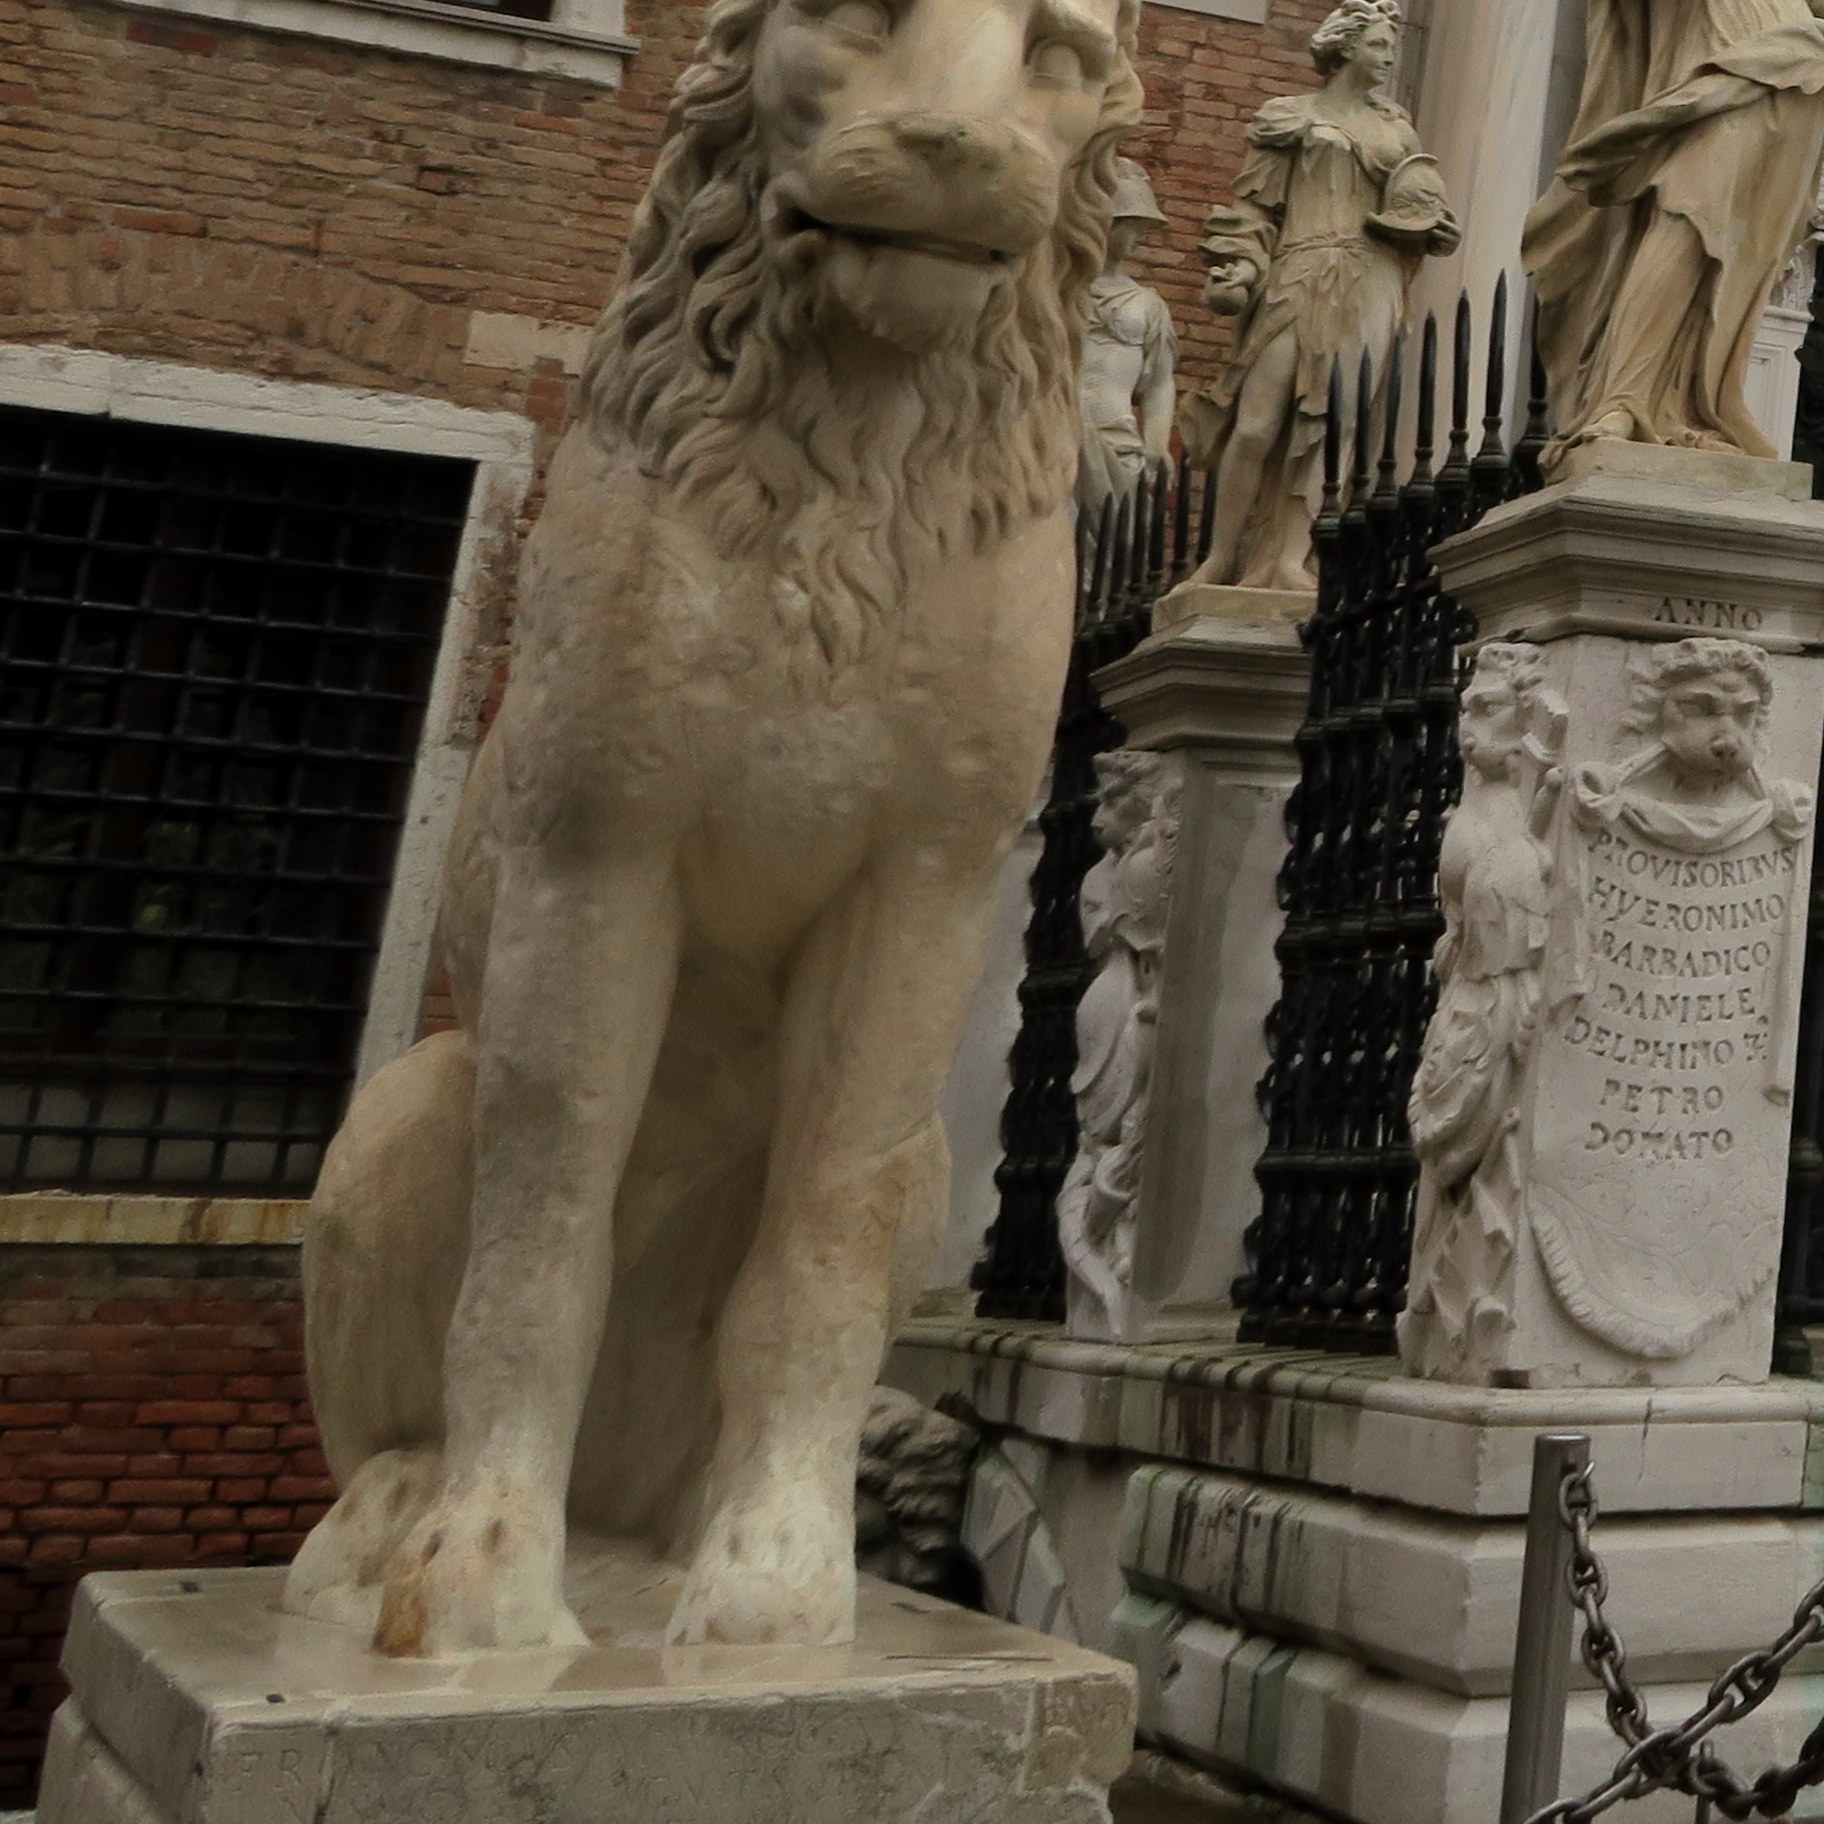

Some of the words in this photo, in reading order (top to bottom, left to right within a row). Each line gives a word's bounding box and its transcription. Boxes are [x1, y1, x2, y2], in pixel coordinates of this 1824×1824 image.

[1655, 596, 1763, 631] ANNO
[1588, 831, 1798, 888] PROVISORIBVS
[1565, 1015, 1734, 1070] DELPHINO
[1599, 1078, 1724, 1115] PETRO
